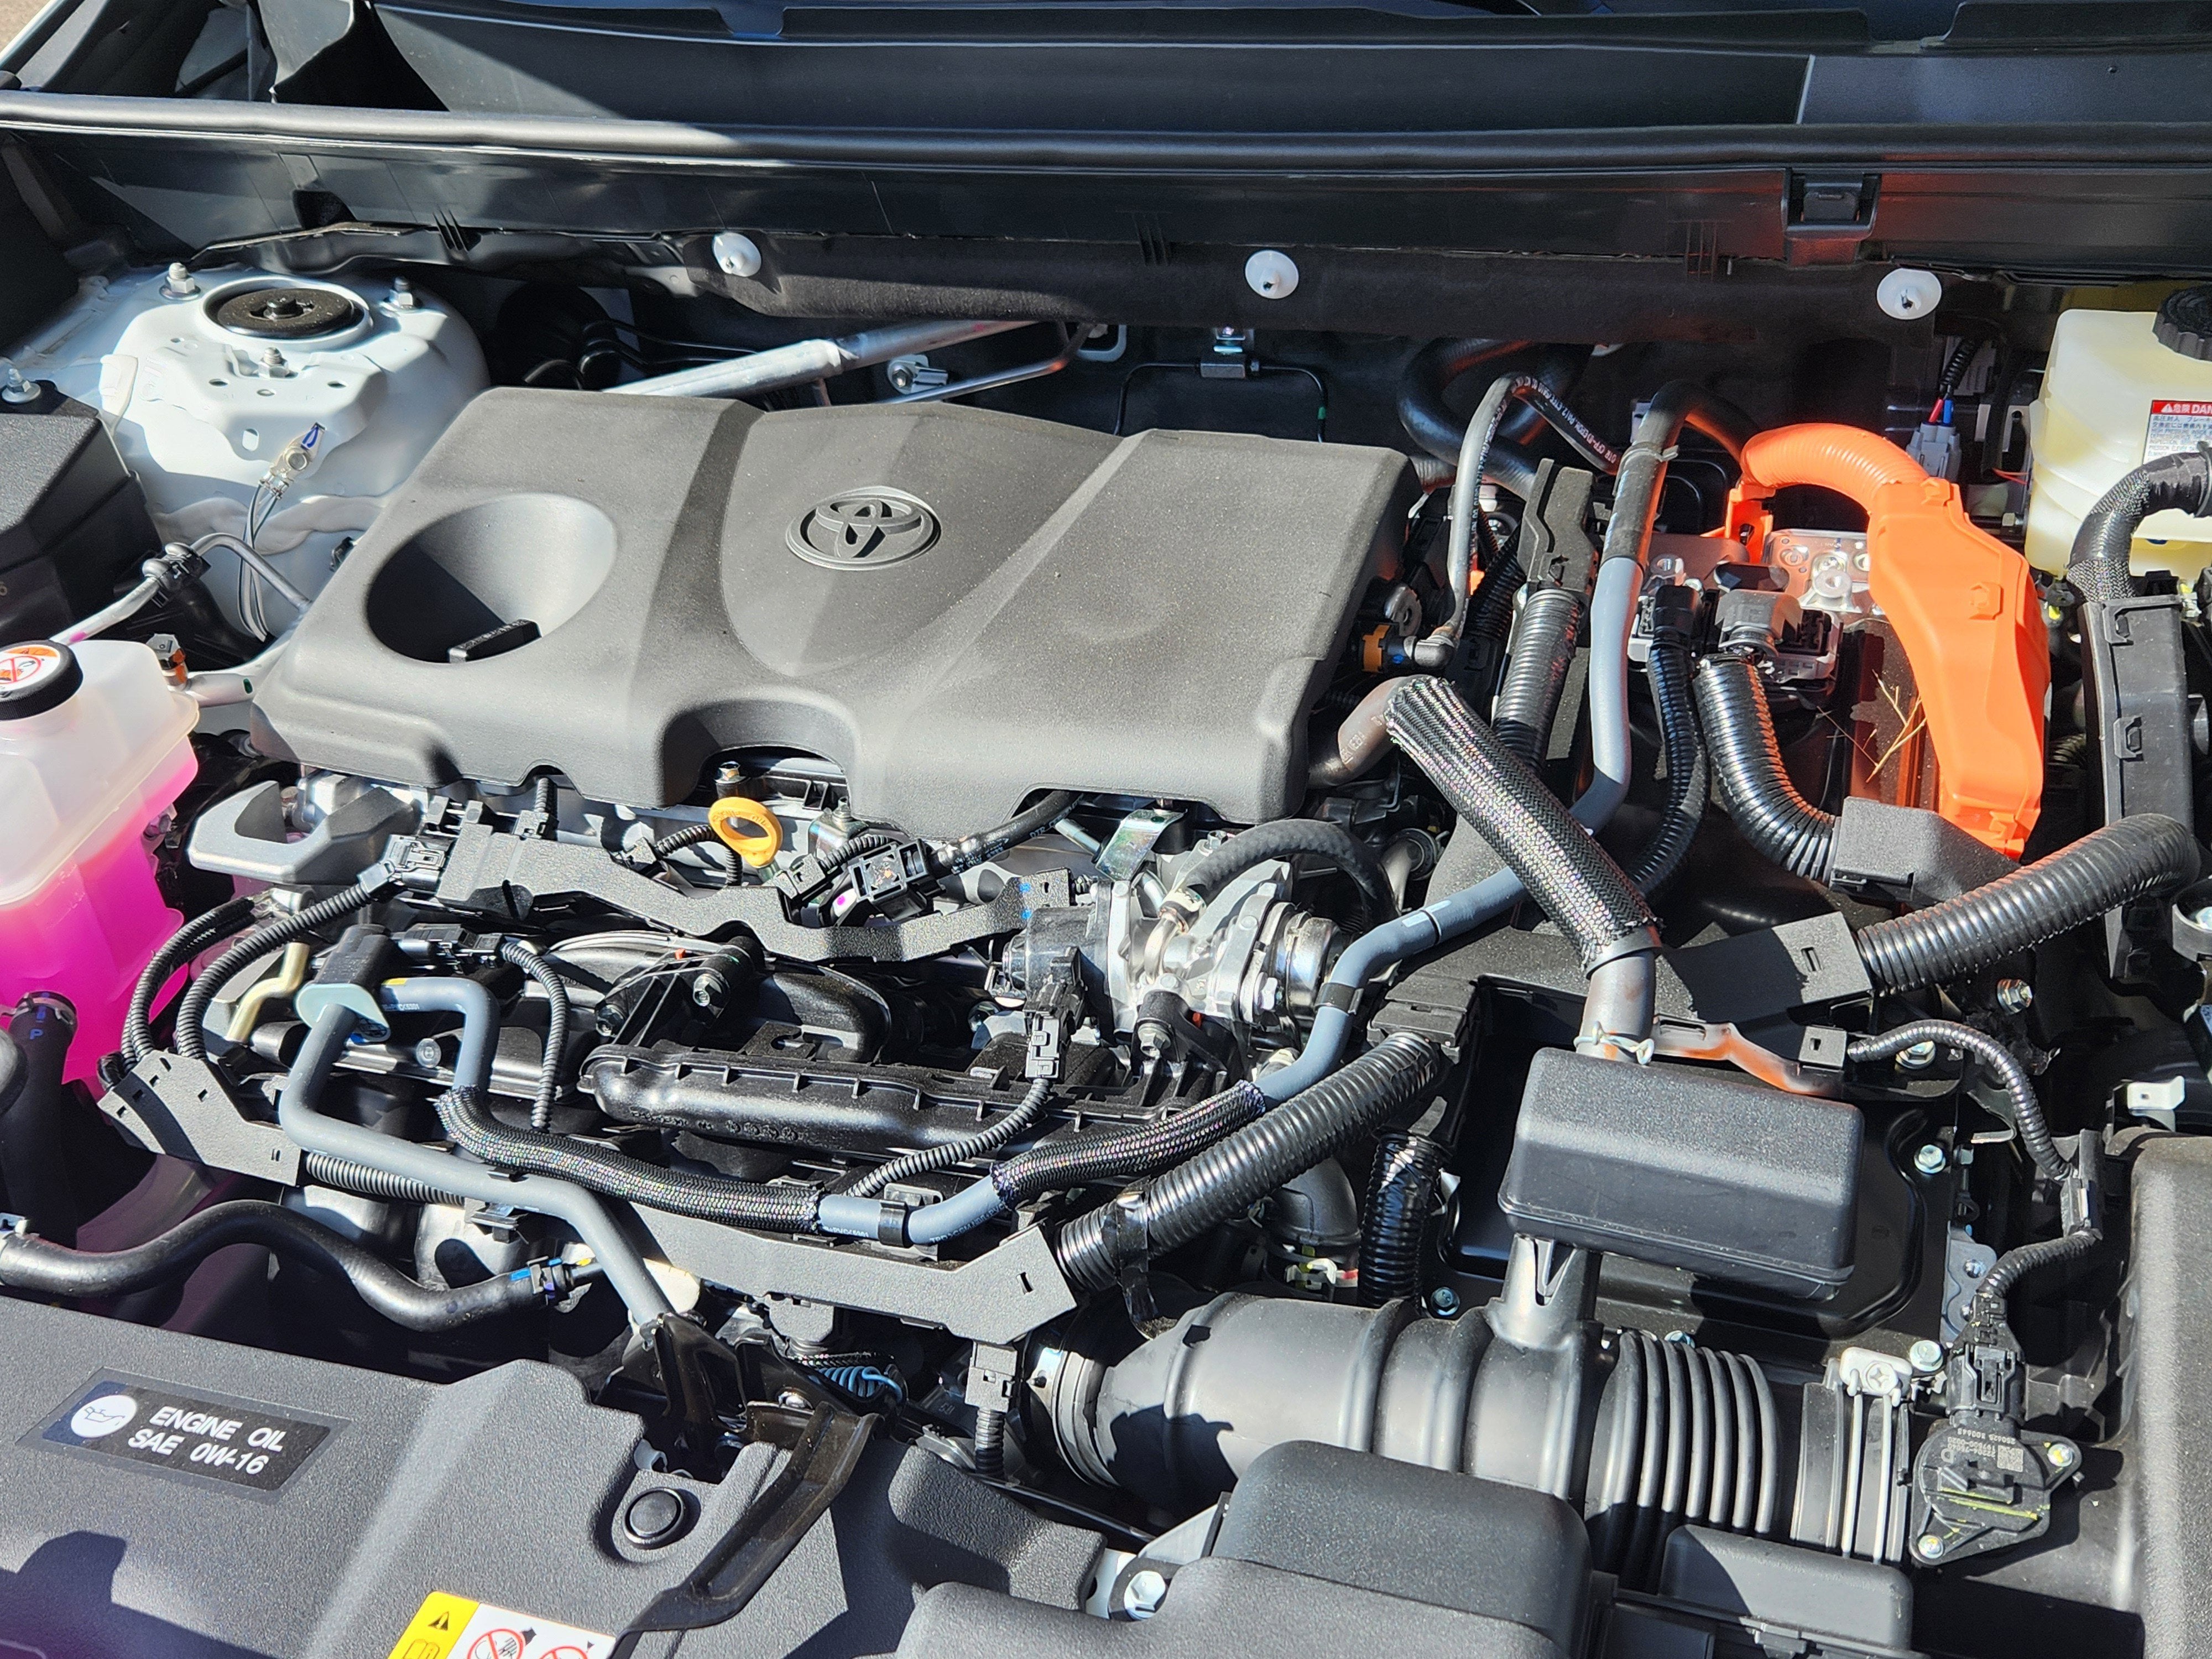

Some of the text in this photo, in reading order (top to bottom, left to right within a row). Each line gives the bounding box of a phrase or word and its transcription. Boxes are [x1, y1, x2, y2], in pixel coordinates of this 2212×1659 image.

[30, 1029, 44, 1040] P
[128, 1428, 269, 1474] SAE 0W-16
[149, 1406, 286, 1452] ENGINE OIL
